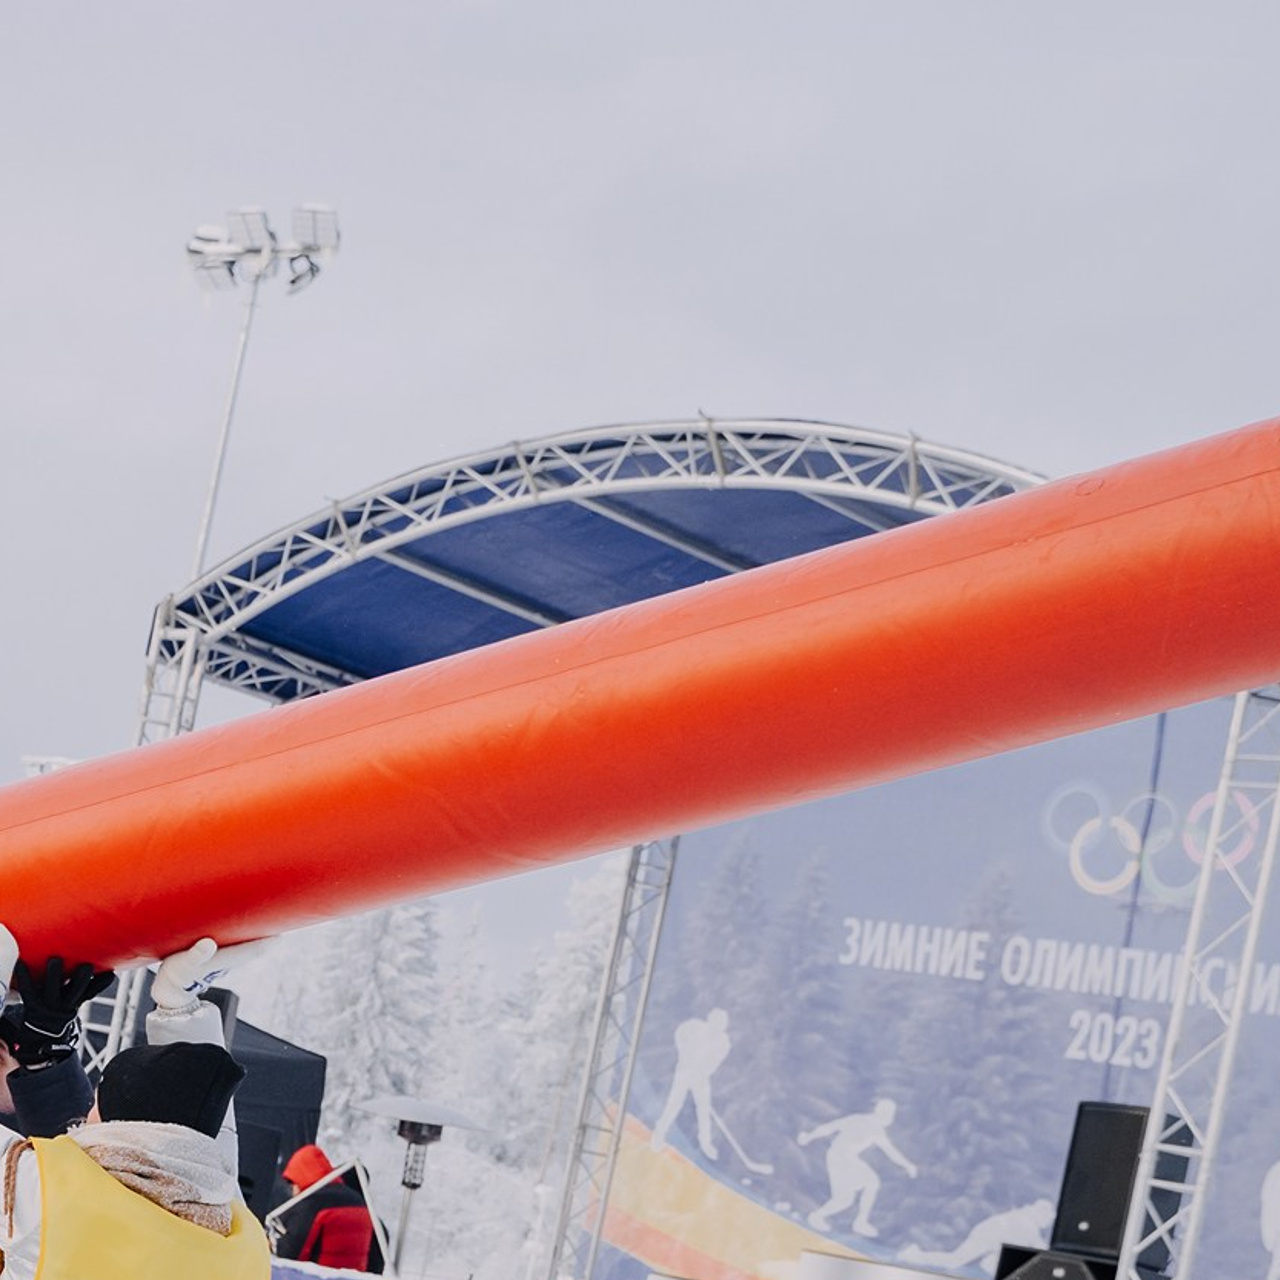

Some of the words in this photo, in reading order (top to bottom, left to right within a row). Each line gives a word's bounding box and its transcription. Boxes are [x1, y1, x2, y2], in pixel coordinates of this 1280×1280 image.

[838, 916, 990, 981] ЗИМНИЕ
[1001, 934, 1280, 1017] ОЛИМПИЙСКИ
[1064, 1009, 1161, 1070] 2023
